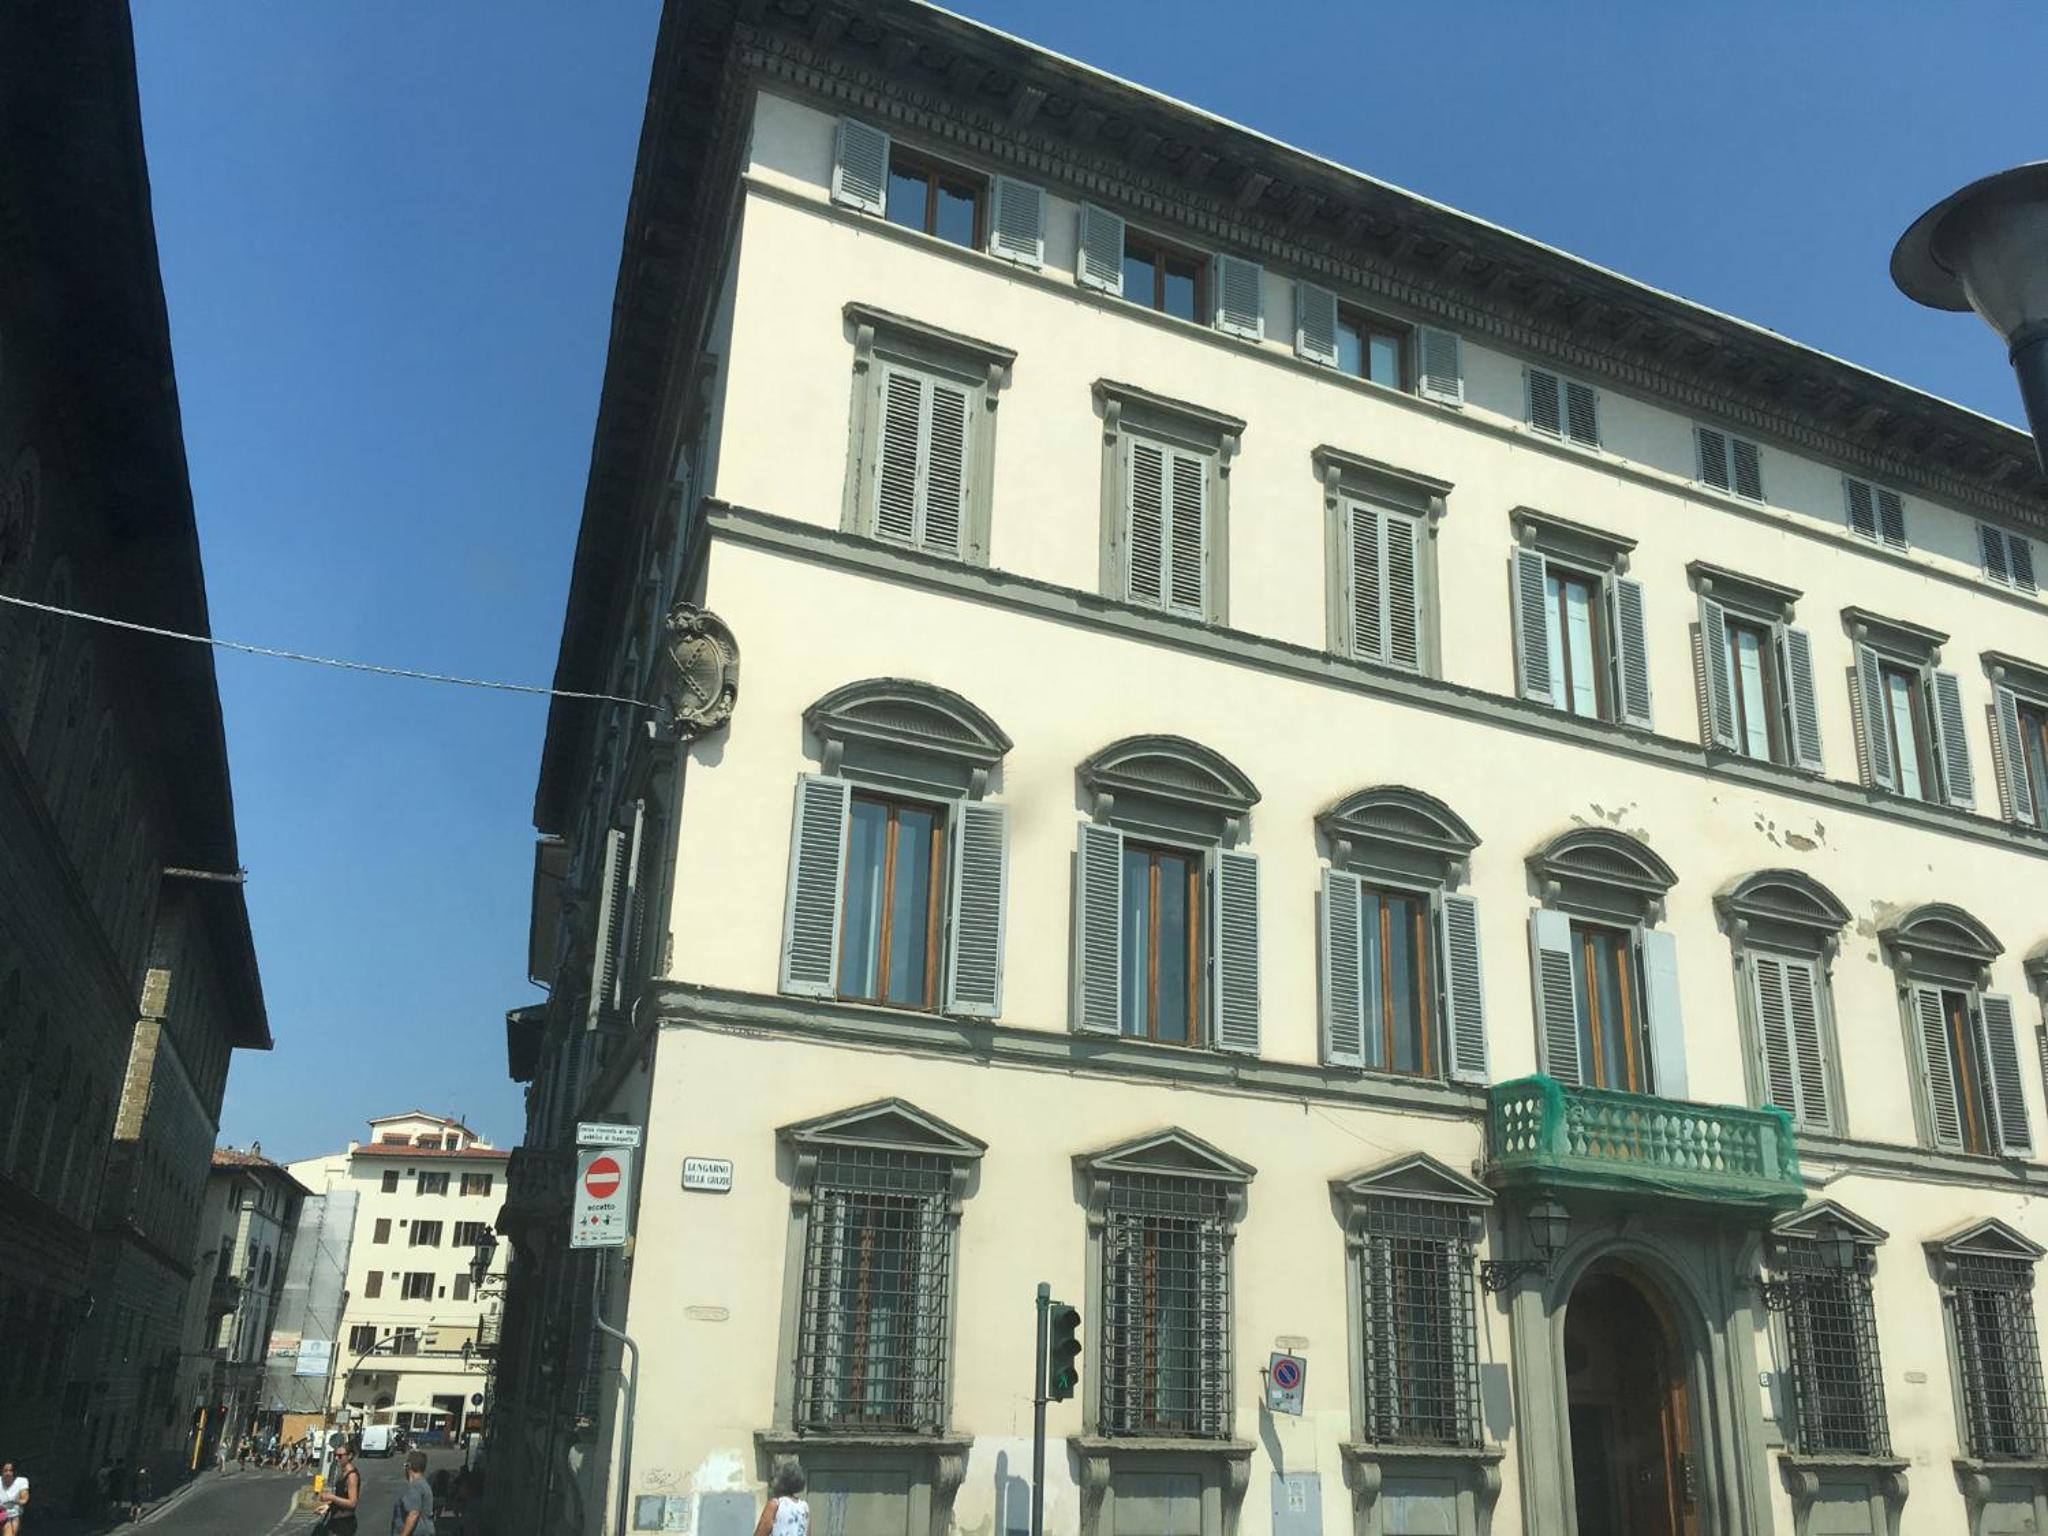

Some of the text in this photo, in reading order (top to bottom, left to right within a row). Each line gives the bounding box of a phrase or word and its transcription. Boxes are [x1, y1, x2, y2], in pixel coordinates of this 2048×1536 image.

[687, 1162, 729, 1173] LUNGARNO
[685, 1174, 731, 1186] DELLE GRAZIE
[587, 1203, 616, 1212] eccetto
